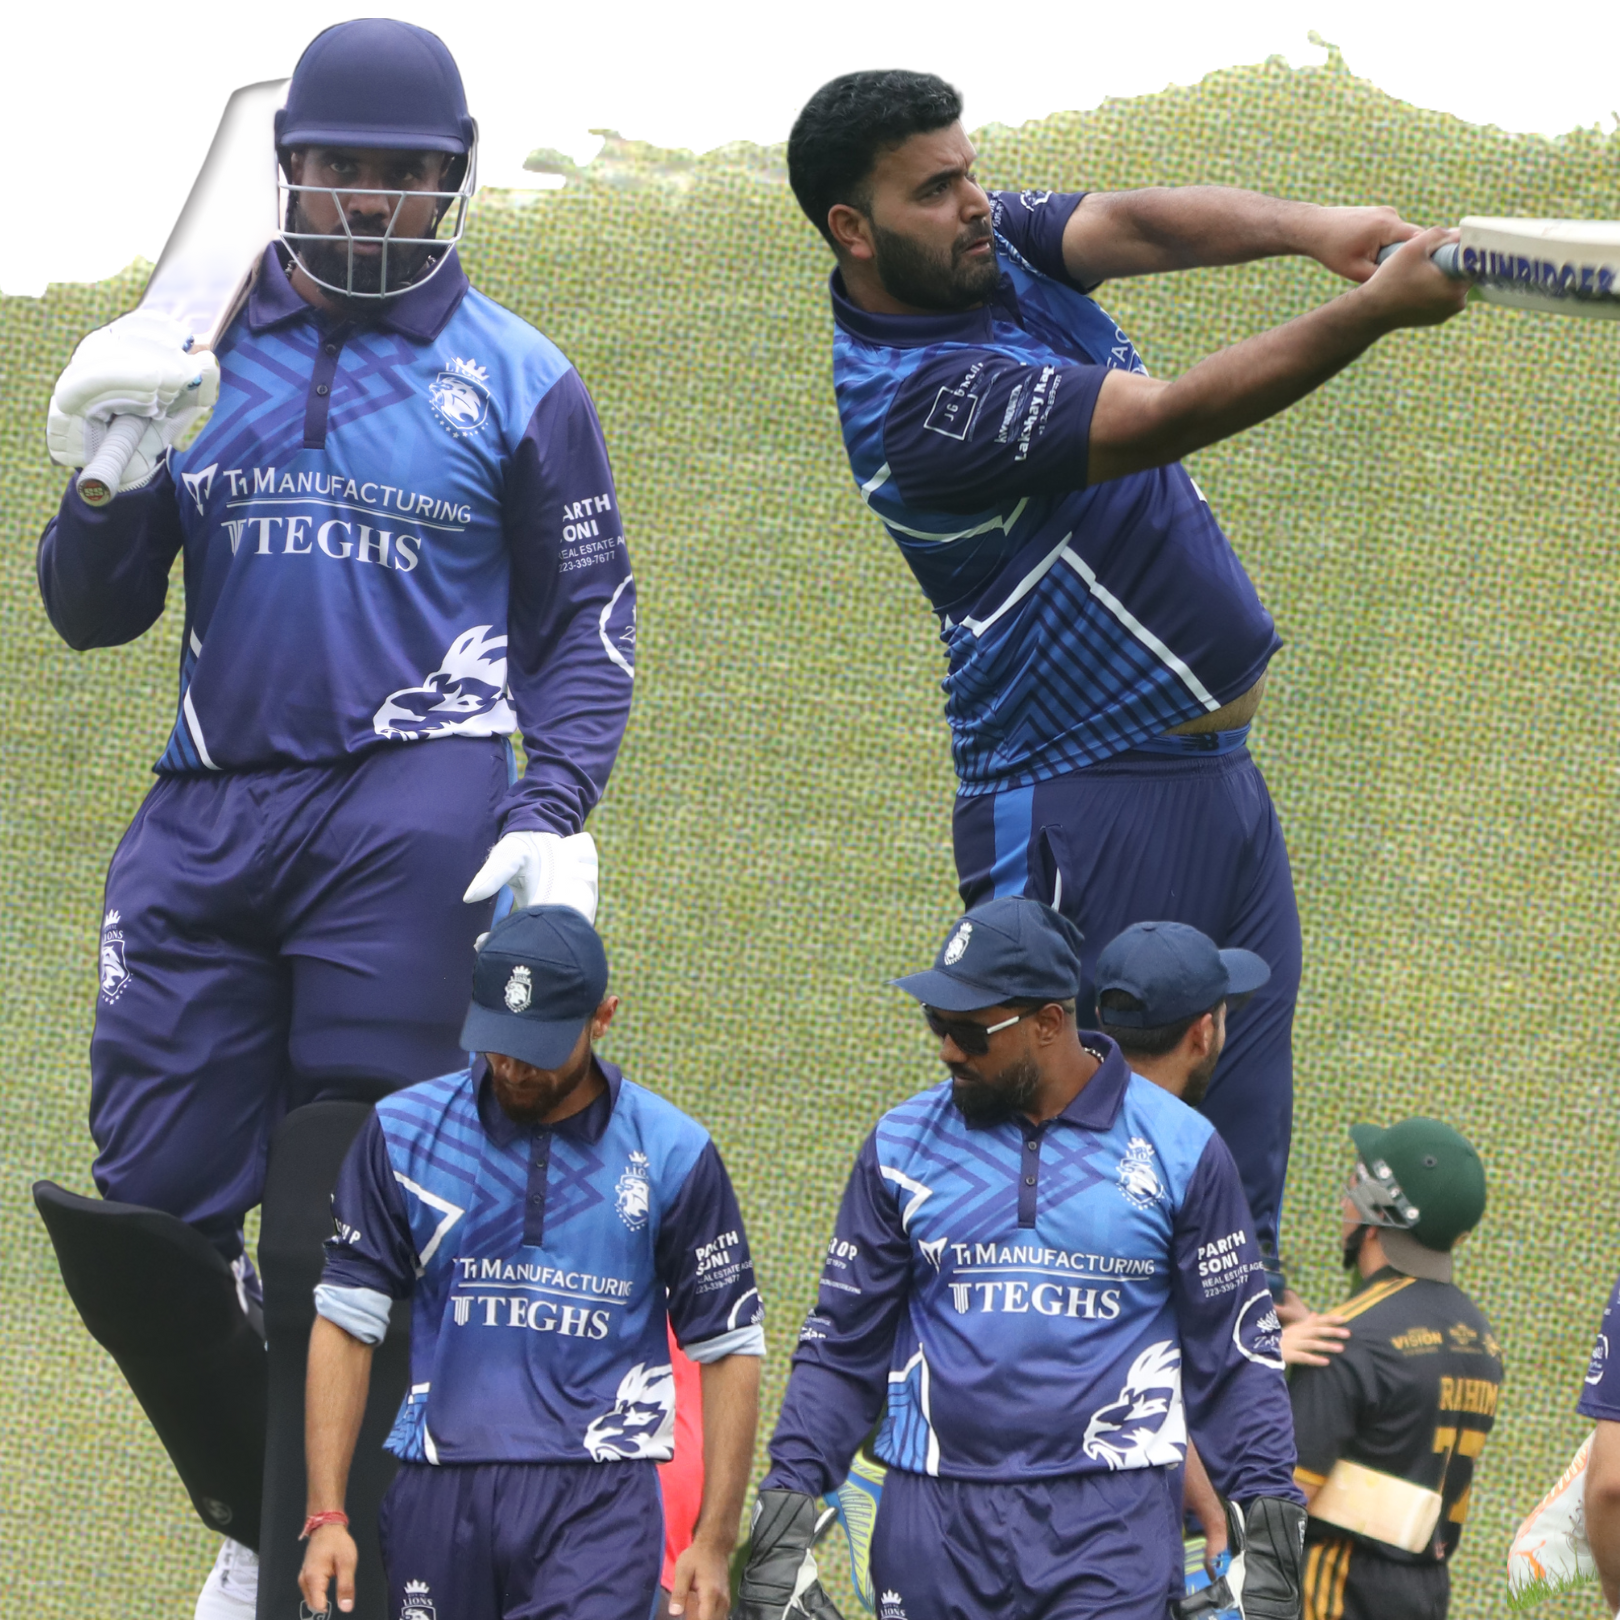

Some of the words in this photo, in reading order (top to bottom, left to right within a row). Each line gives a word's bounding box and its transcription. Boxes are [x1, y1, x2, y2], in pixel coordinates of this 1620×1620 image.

[252, 466, 471, 525] MANUFACTURING
[562, 494, 612, 523] ARTH
[247, 515, 423, 573] TEGHS
[560, 519, 600, 544] ONI
[579, 538, 616, 555] ESTATE
[974, 1241, 1155, 1275] MANUFACTURING
[1198, 1229, 1247, 1261] PARTH
[713, 1264, 740, 1280] ESTATE
[1198, 1251, 1239, 1277] SONI
[1202, 1277, 1225, 1289] REAL
[974, 1281, 1142, 1319] TEGHS
[477, 1295, 611, 1340] TEGHS
[1391, 1330, 1443, 1350] VISION
[403, 1598, 433, 1608] LIONS
